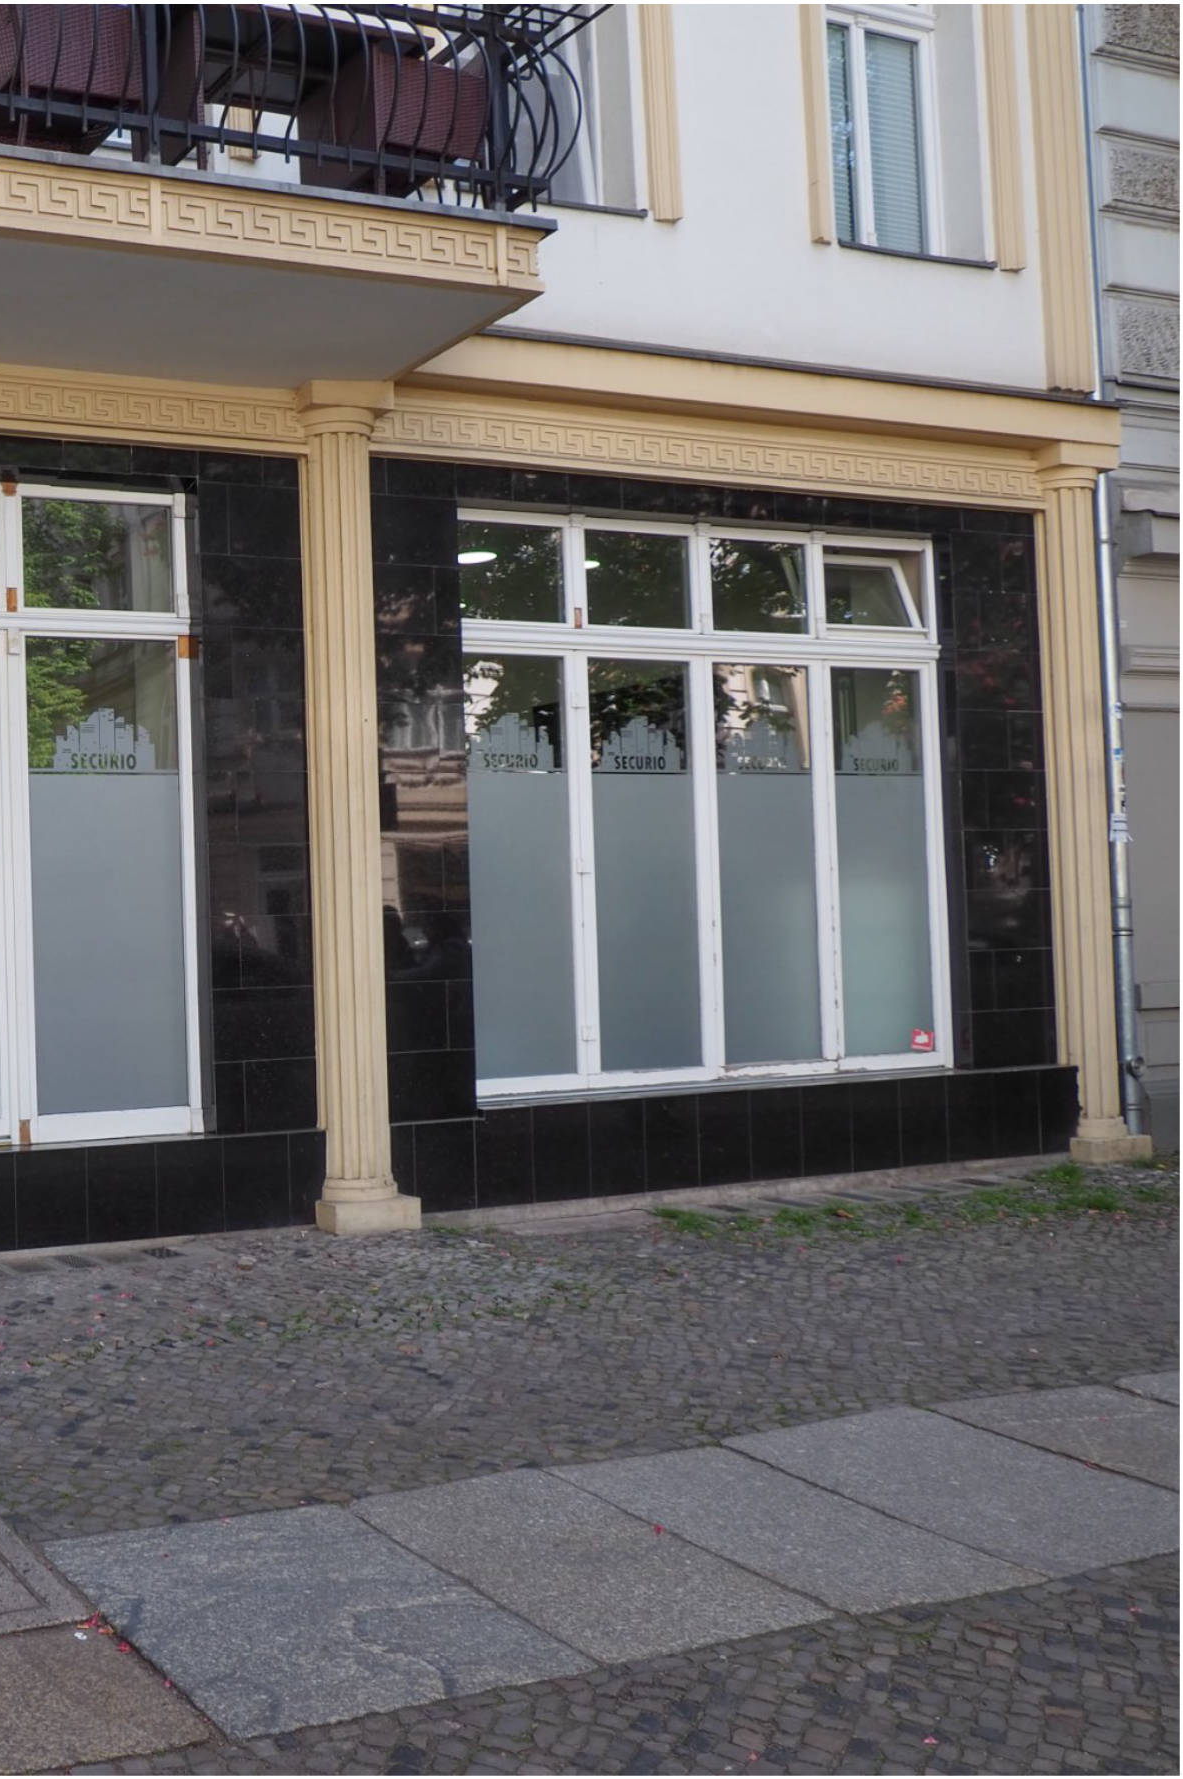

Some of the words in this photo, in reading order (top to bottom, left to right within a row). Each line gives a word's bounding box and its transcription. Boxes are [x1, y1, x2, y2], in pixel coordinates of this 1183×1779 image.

[70, 753, 137, 770] SECURIO
[483, 752, 539, 769] SECURIO
[614, 754, 666, 771] SECURIO
[853, 757, 900, 772] SECURIO
